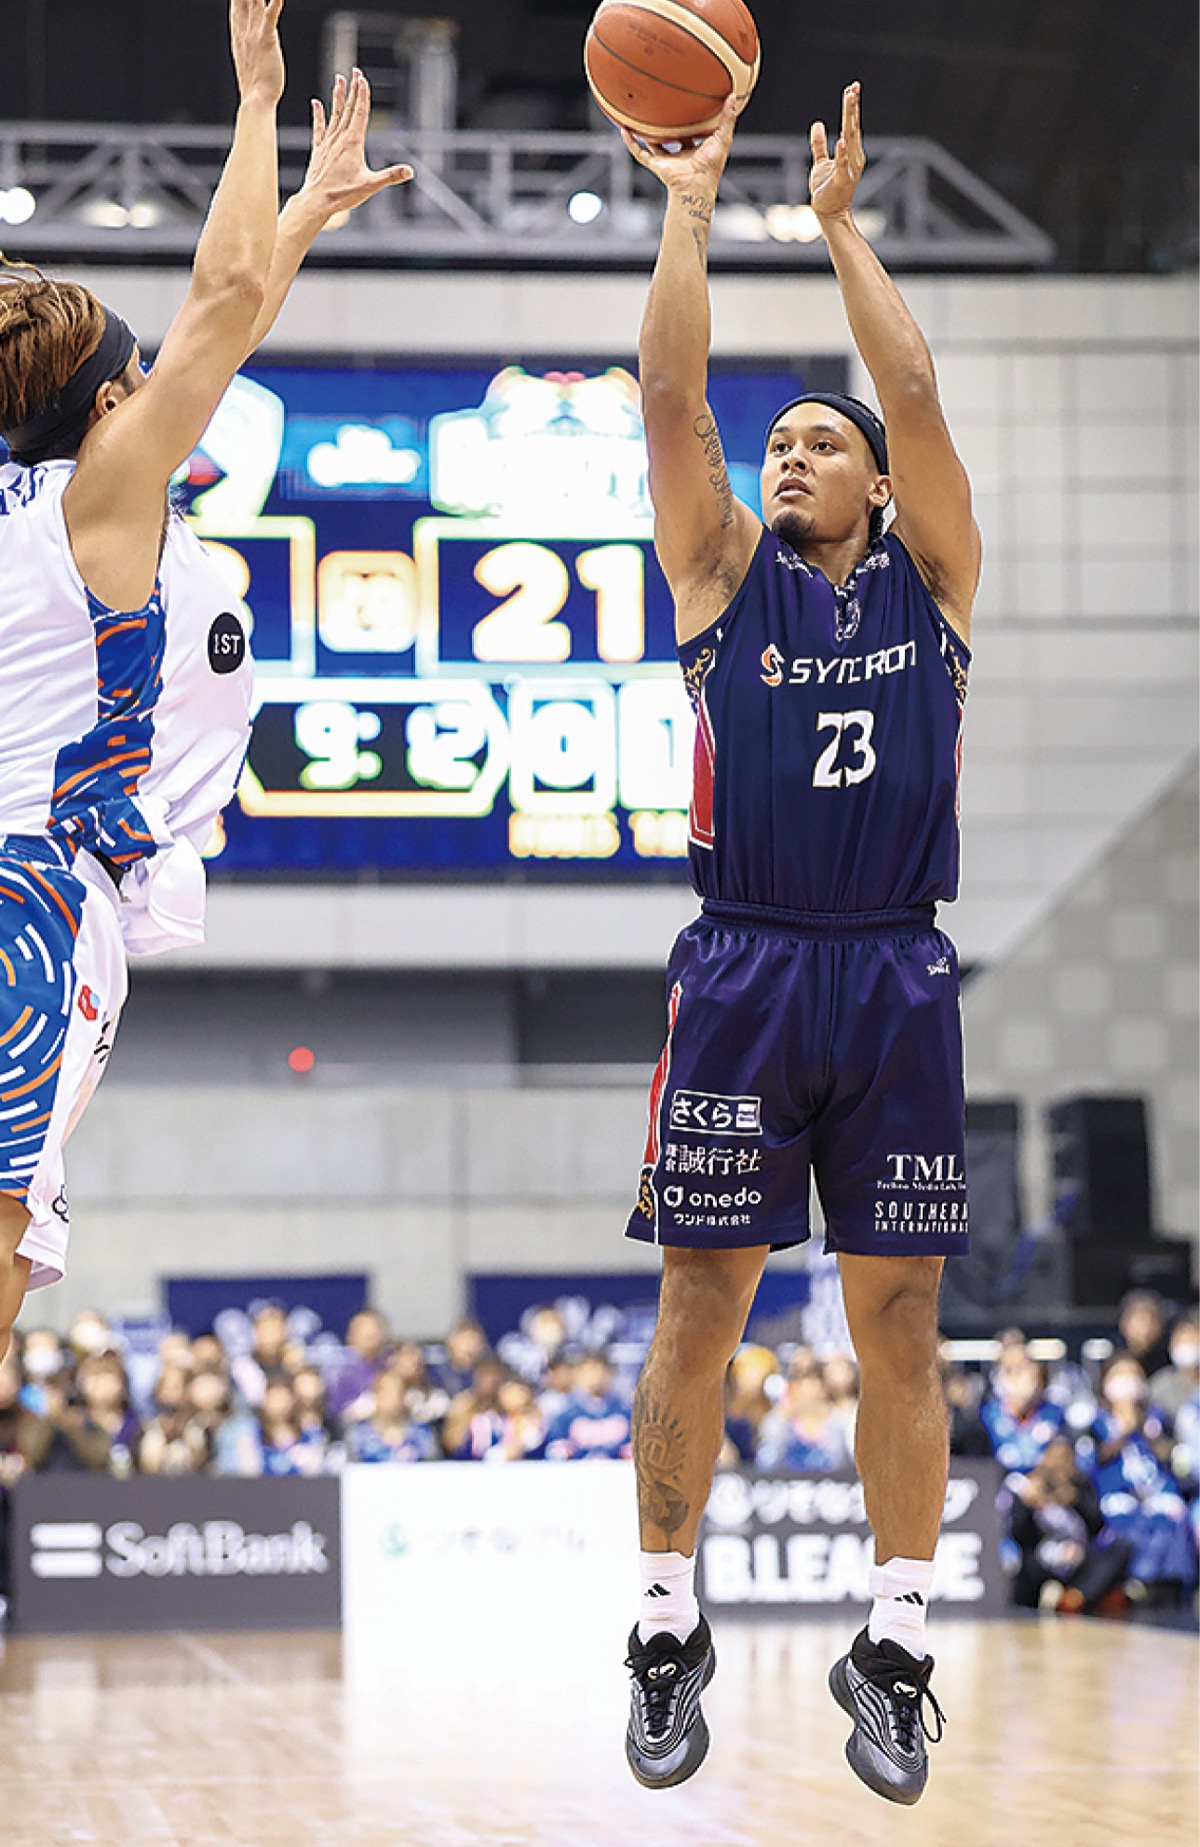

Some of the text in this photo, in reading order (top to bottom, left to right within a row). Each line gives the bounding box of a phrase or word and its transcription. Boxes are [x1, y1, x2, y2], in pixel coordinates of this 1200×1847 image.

[473, 543, 645, 662] 21
[812, 709, 877, 788] 23
[673, 1097, 733, 1128] さくら
[886, 1154, 964, 1181] TML
[689, 1187, 762, 1208] onedo
[105, 1520, 328, 1577] SoftBank
